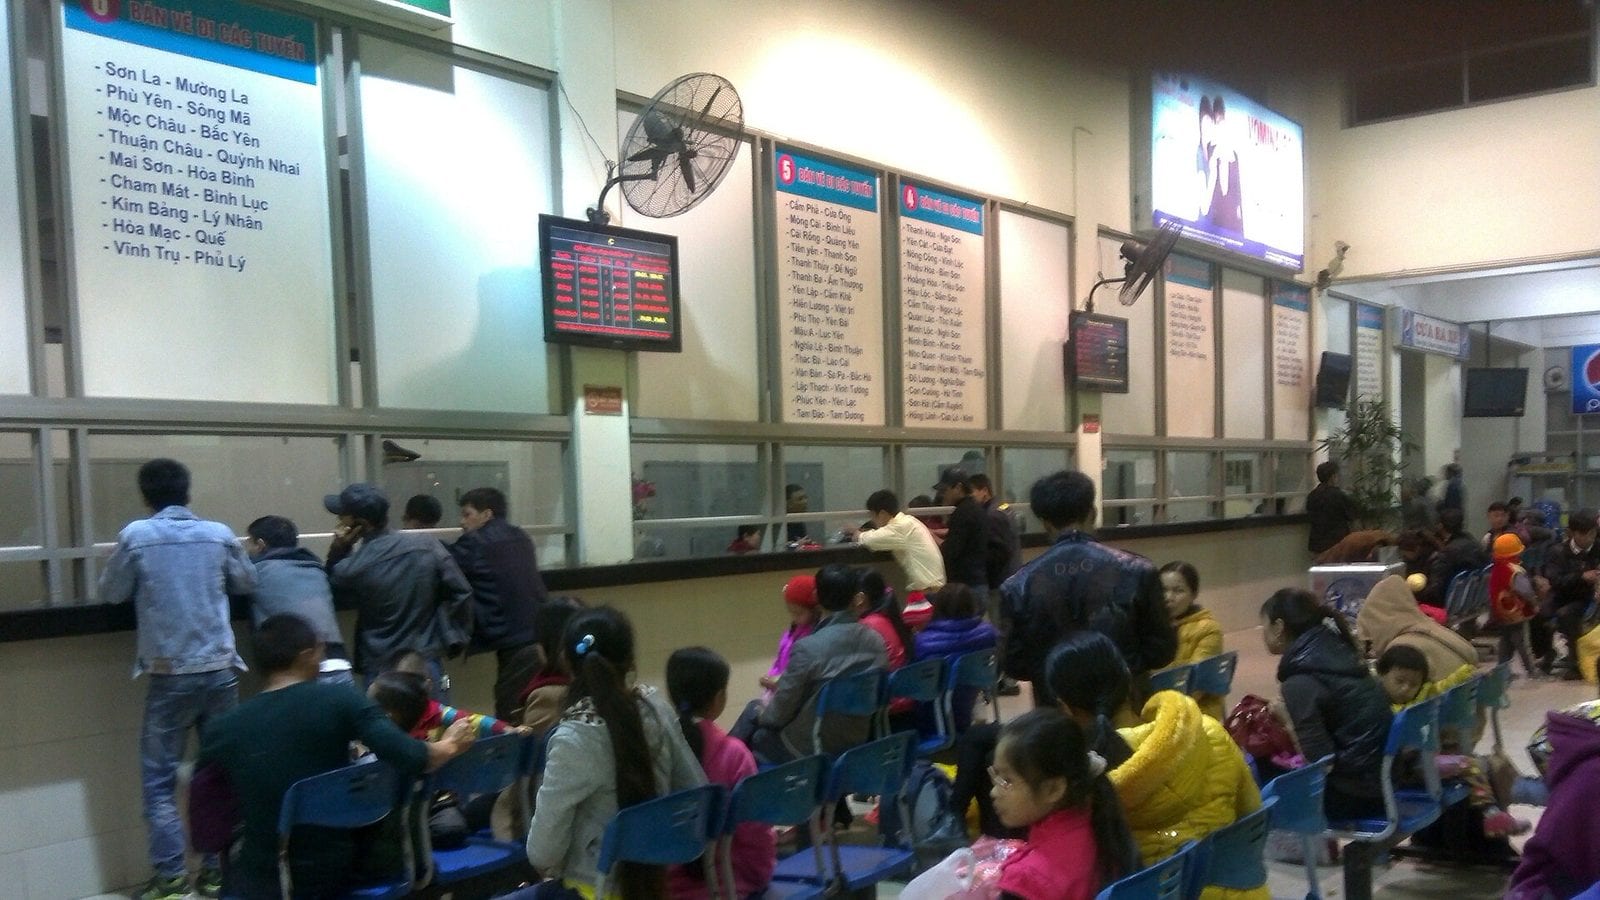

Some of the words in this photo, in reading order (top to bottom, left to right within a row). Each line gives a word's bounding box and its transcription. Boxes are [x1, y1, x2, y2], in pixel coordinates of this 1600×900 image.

[196, 17, 216, 40] ĐI
[106, 61, 137, 81] Sơn
[143, 70, 160, 86] La
[176, 77, 226, 102] Mường
[232, 89, 249, 105] La
[107, 84, 138, 103] Phù
[143, 91, 172, 110] Yên
[187, 101, 226, 125] Sông
[230, 110, 251, 126] Mã
[108, 106, 141, 128] Mộc
[146, 112, 186, 134] Châu
[201, 125, 229, 143] Bắc
[233, 131, 260, 148] Yên
[109, 129, 158, 152] Thuận
[163, 139, 203, 158] Châu
[268, 158, 300, 176] Nhai
[110, 152, 137, 169] Mai
[143, 157, 173, 174] Sơn
[782, 160, 791, 181] 5
[111, 174, 157, 194] Cham
[163, 182, 190, 199] Mát
[242, 195, 268, 213] Lục
[112, 196, 143, 213] Kim
[203, 210, 221, 227] Lý
[225, 213, 263, 231] Nhân
[150, 223, 181, 243] Mạc
[195, 230, 226, 246] Quế
[114, 241, 150, 258] Vĩnh
[155, 246, 180, 265] Trụ
[229, 255, 246, 272] Lý
[1055, 559, 1094, 576] D&G
